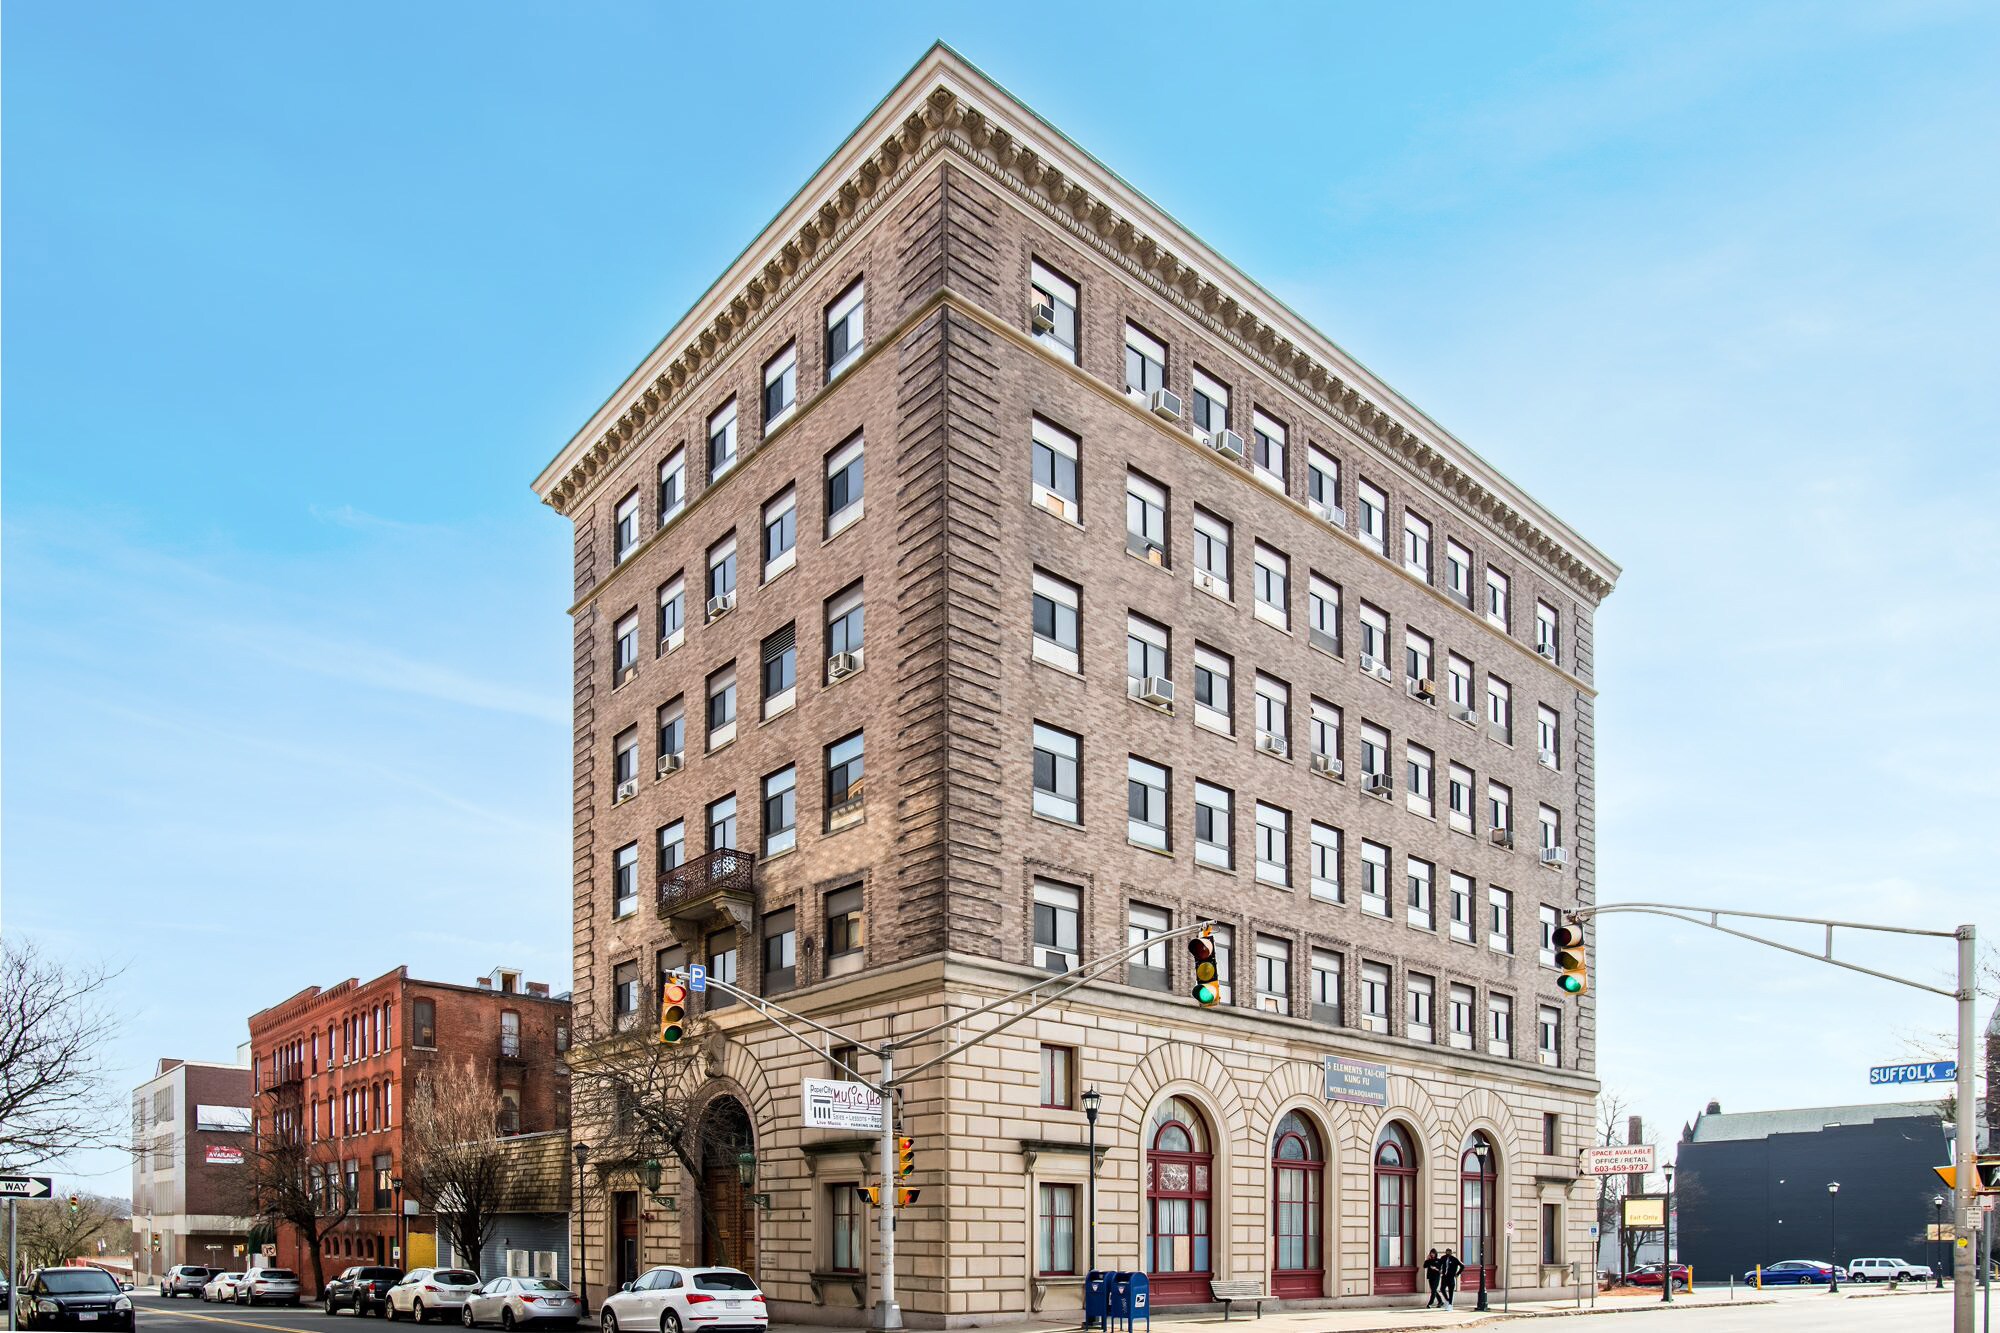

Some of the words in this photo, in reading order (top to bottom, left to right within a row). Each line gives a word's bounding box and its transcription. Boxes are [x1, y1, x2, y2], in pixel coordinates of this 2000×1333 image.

[1327, 1061, 1331, 1070] 5
[1333, 1063, 1362, 1075] ELEMENTS
[1364, 1069, 1385, 1078] TAI-CHI
[1870, 1064, 1936, 1083] SUFFOLK
[1944, 1069, 1954, 1077] ST
[1344, 1074, 1361, 1084] KUNG
[1362, 1077, 1370, 1086] FU
[865, 1089, 881, 1110] SHO
[1329, 1086, 1347, 1095] WORLD
[1348, 1089, 1384, 1100] HEADQUARTERS
[1615, 1148, 1652, 1156] AVAILABLE
[1594, 1164, 1649, 1172] 603-459-9737
[4, 1182, 27, 1191] WAY
